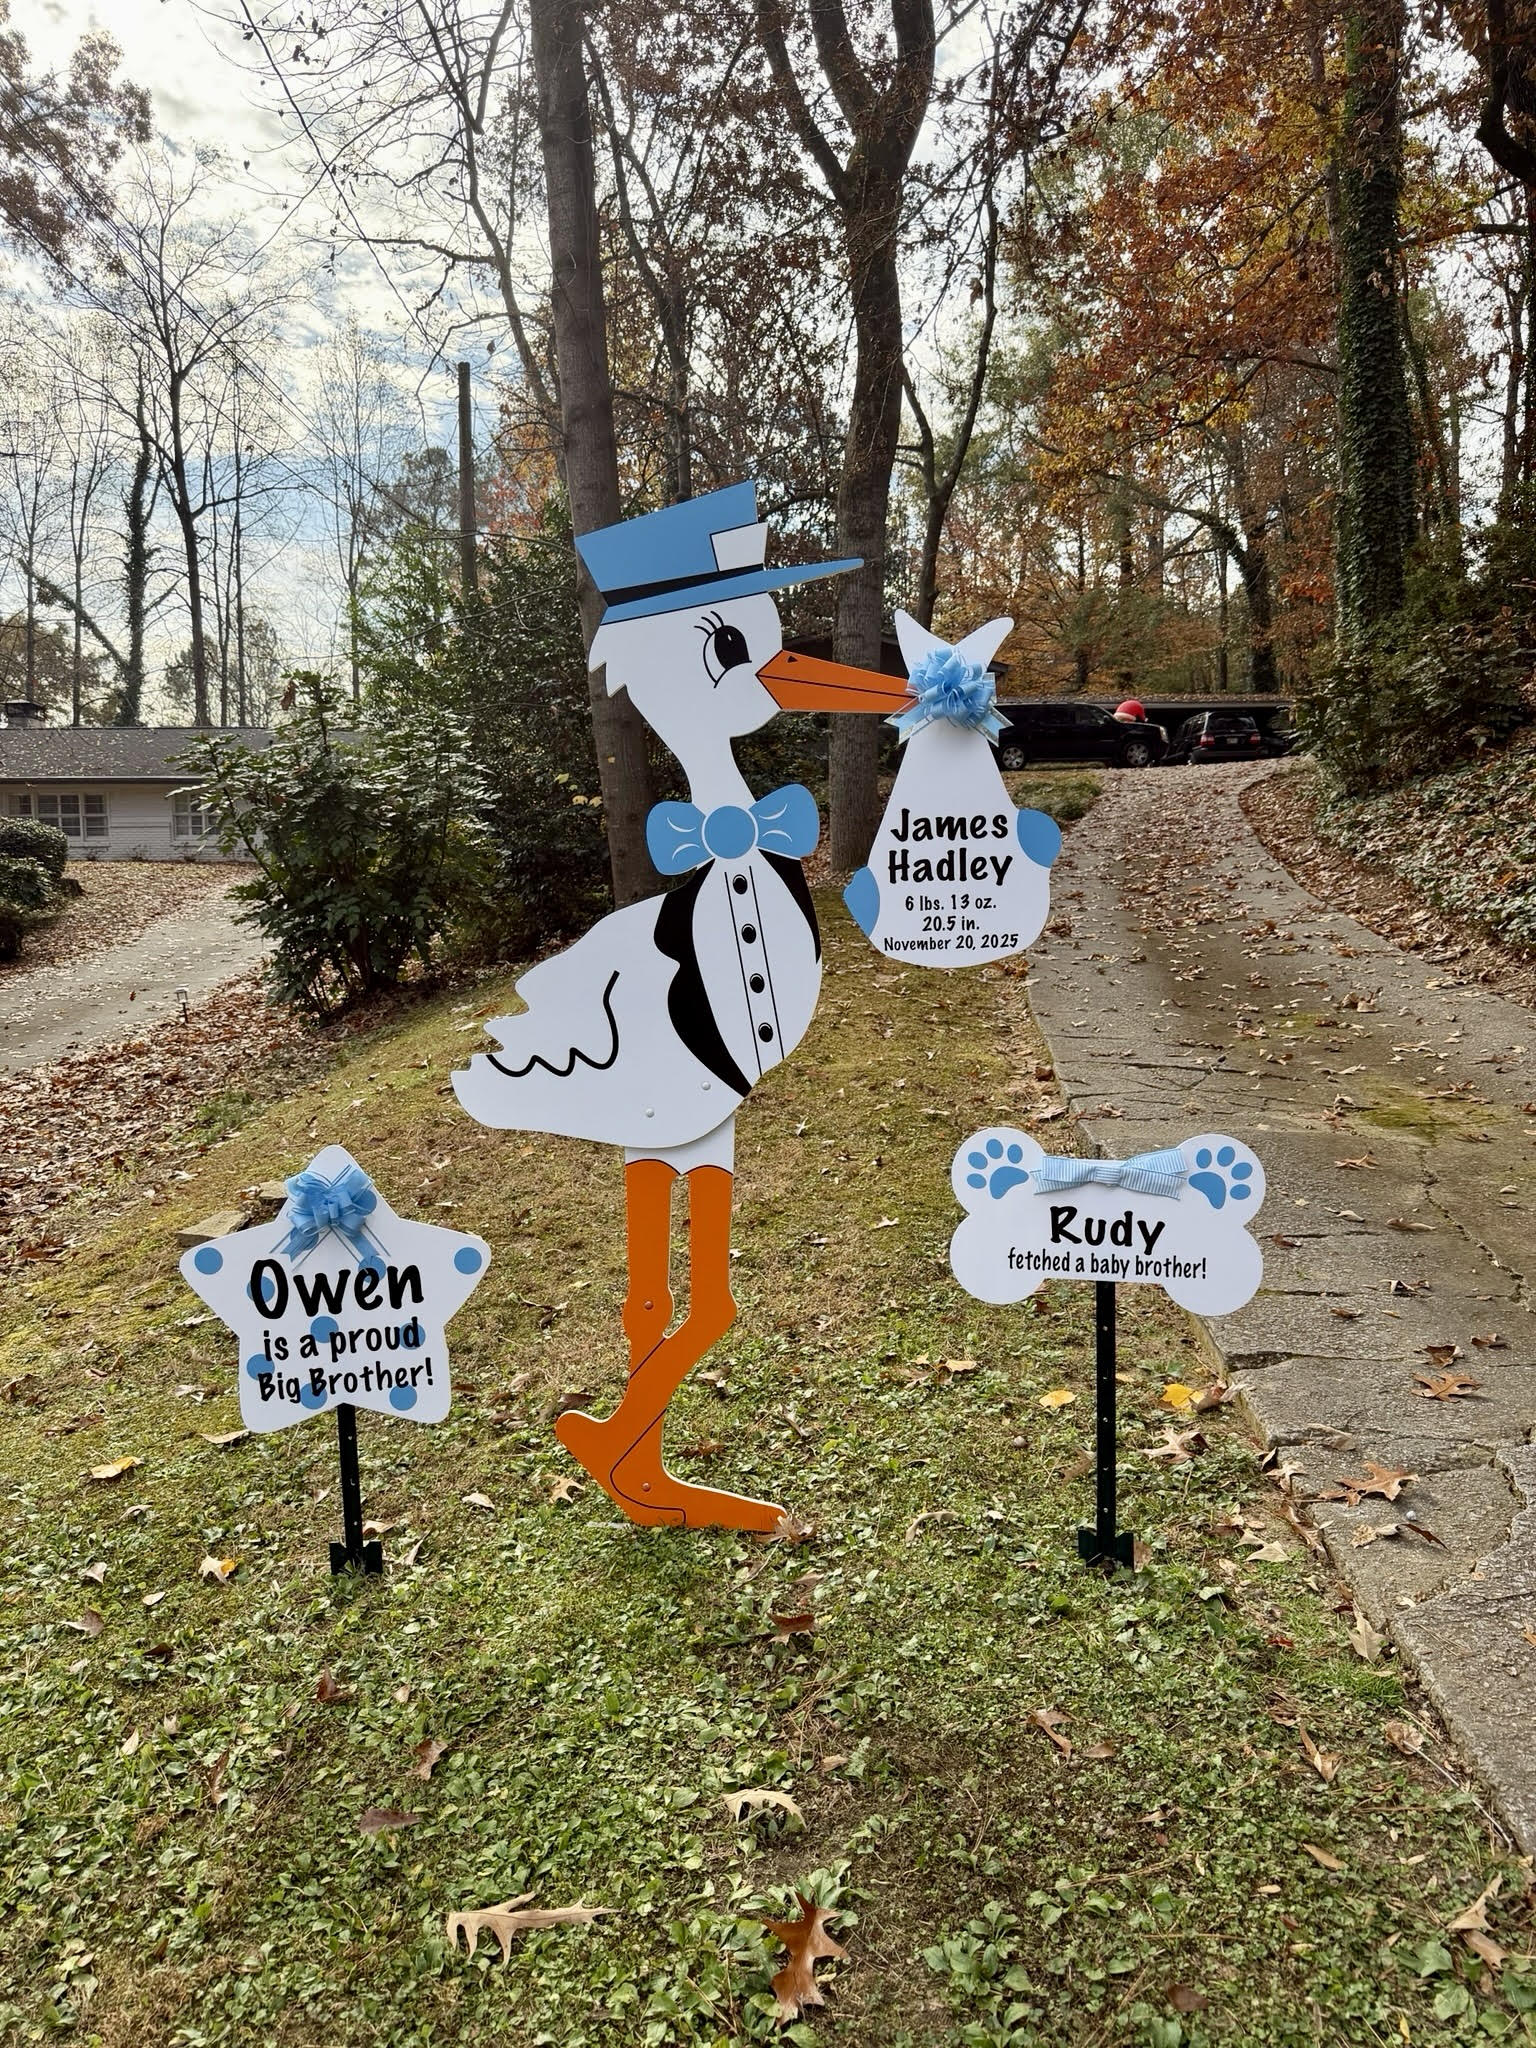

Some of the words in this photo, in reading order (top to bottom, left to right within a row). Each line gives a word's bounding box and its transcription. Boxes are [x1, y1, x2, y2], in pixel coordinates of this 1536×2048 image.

[890, 808, 1009, 842] James
[888, 848, 1013, 886] Hadley
[905, 895, 914, 912] 6
[919, 895, 944, 912] lbs.
[950, 893, 970, 910] 13
[975, 897, 997, 910] oz.
[922, 915, 957, 932] 20.5
[961, 915, 980, 931] in.
[884, 936, 952, 952] November
[955, 934, 976, 951] 20,
[980, 933, 1019, 949] 2025
[1049, 1205, 1166, 1255] Rudy
[1007, 1246, 1070, 1272] fetched
[1075, 1257, 1085, 1273] a
[1090, 1252, 1130, 1279] baby
[1135, 1252, 1207, 1280] brother!
[250, 1258, 424, 1320] Owen
[263, 1329, 289, 1362] is
[299, 1334, 320, 1359] a
[329, 1316, 421, 1363] proud
[258, 1372, 301, 1403] Big
[309, 1357, 434, 1397] Brother!
